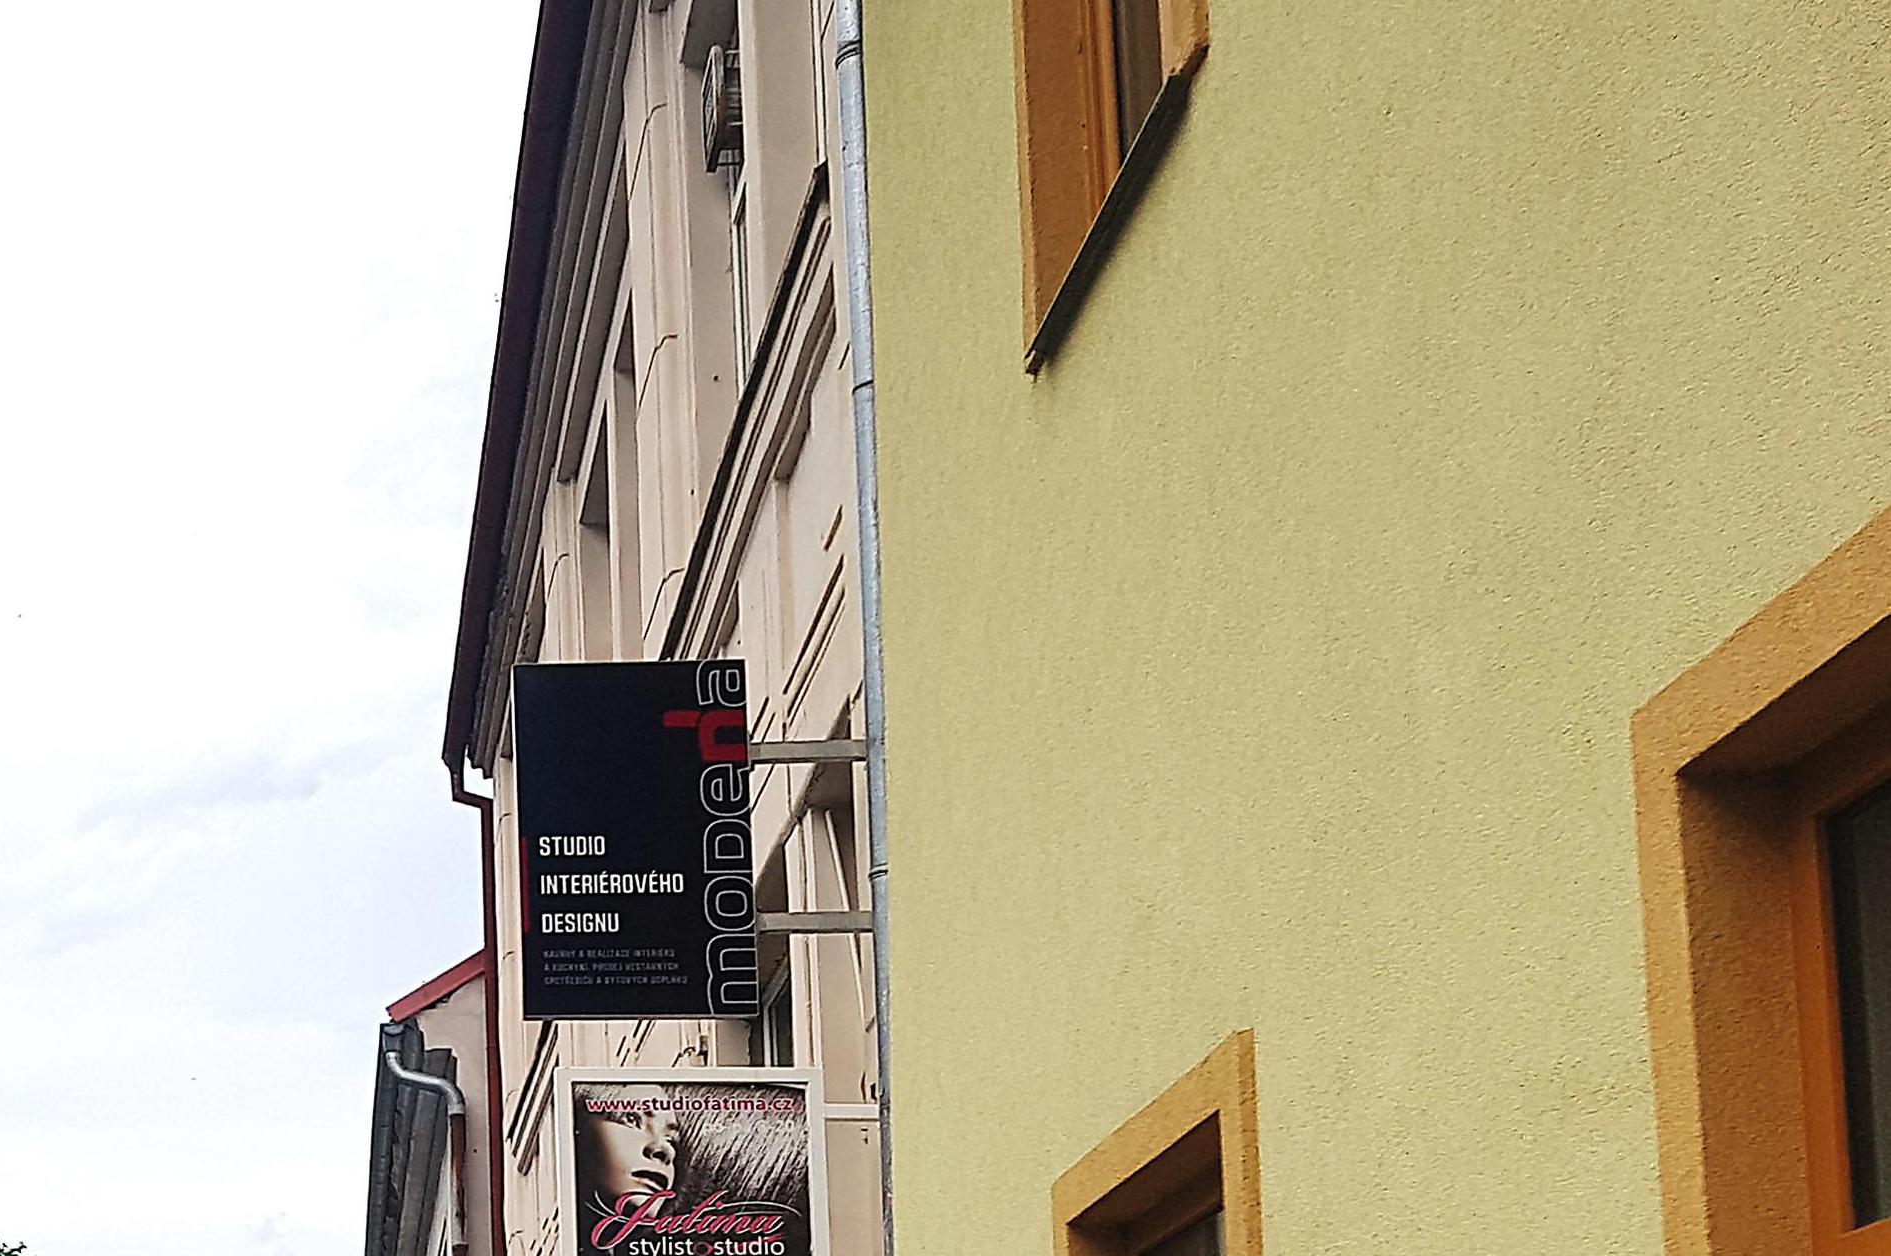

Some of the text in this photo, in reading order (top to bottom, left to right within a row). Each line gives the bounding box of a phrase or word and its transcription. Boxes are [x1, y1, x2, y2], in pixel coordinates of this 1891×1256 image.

[539, 835, 606, 857] STUDIO
[540, 869, 684, 895] INTERIÉROVÉHO
[541, 912, 620, 934] DESIGNU
[586, 1096, 793, 1113] www.studiofatima.cz
[590, 1190, 785, 1250] Fatima
[713, 1236, 785, 1256] studio
